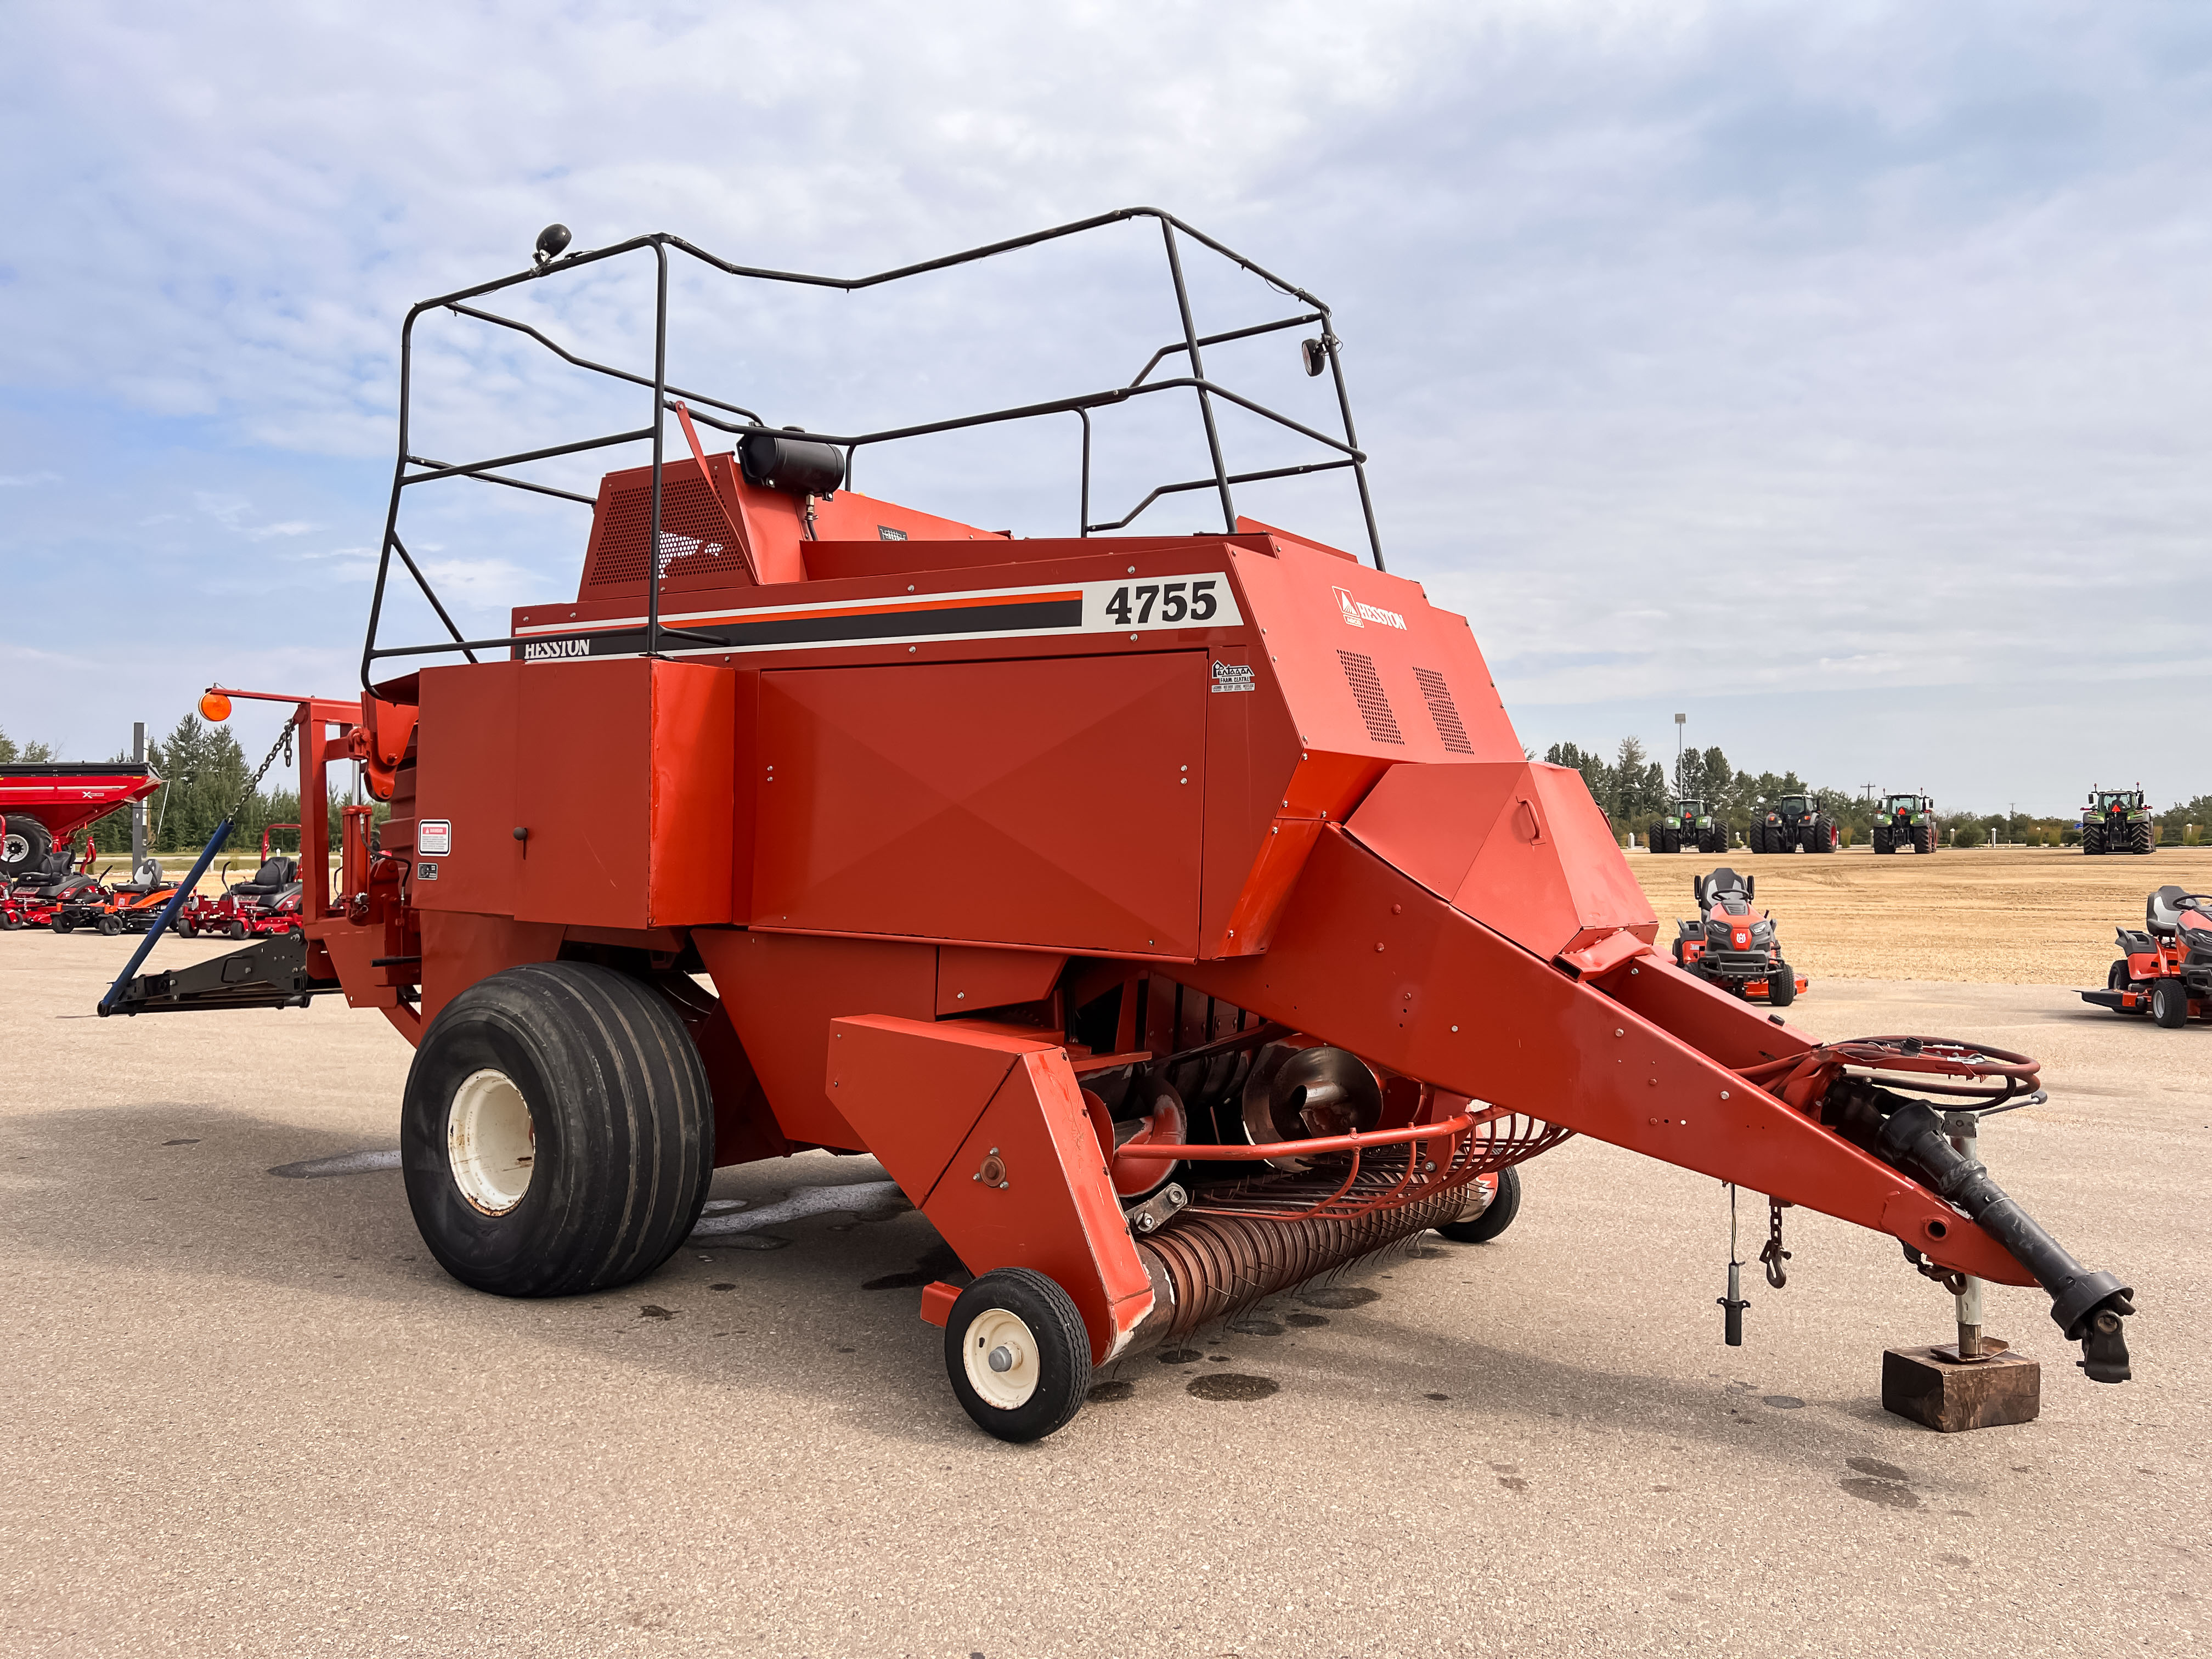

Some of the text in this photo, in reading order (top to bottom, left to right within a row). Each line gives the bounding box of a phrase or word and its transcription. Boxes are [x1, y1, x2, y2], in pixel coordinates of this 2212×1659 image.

[1105, 580, 1217, 624] 4755
[1356, 602, 1407, 630] HESSTON
[524, 639, 590, 659] HESSTON
